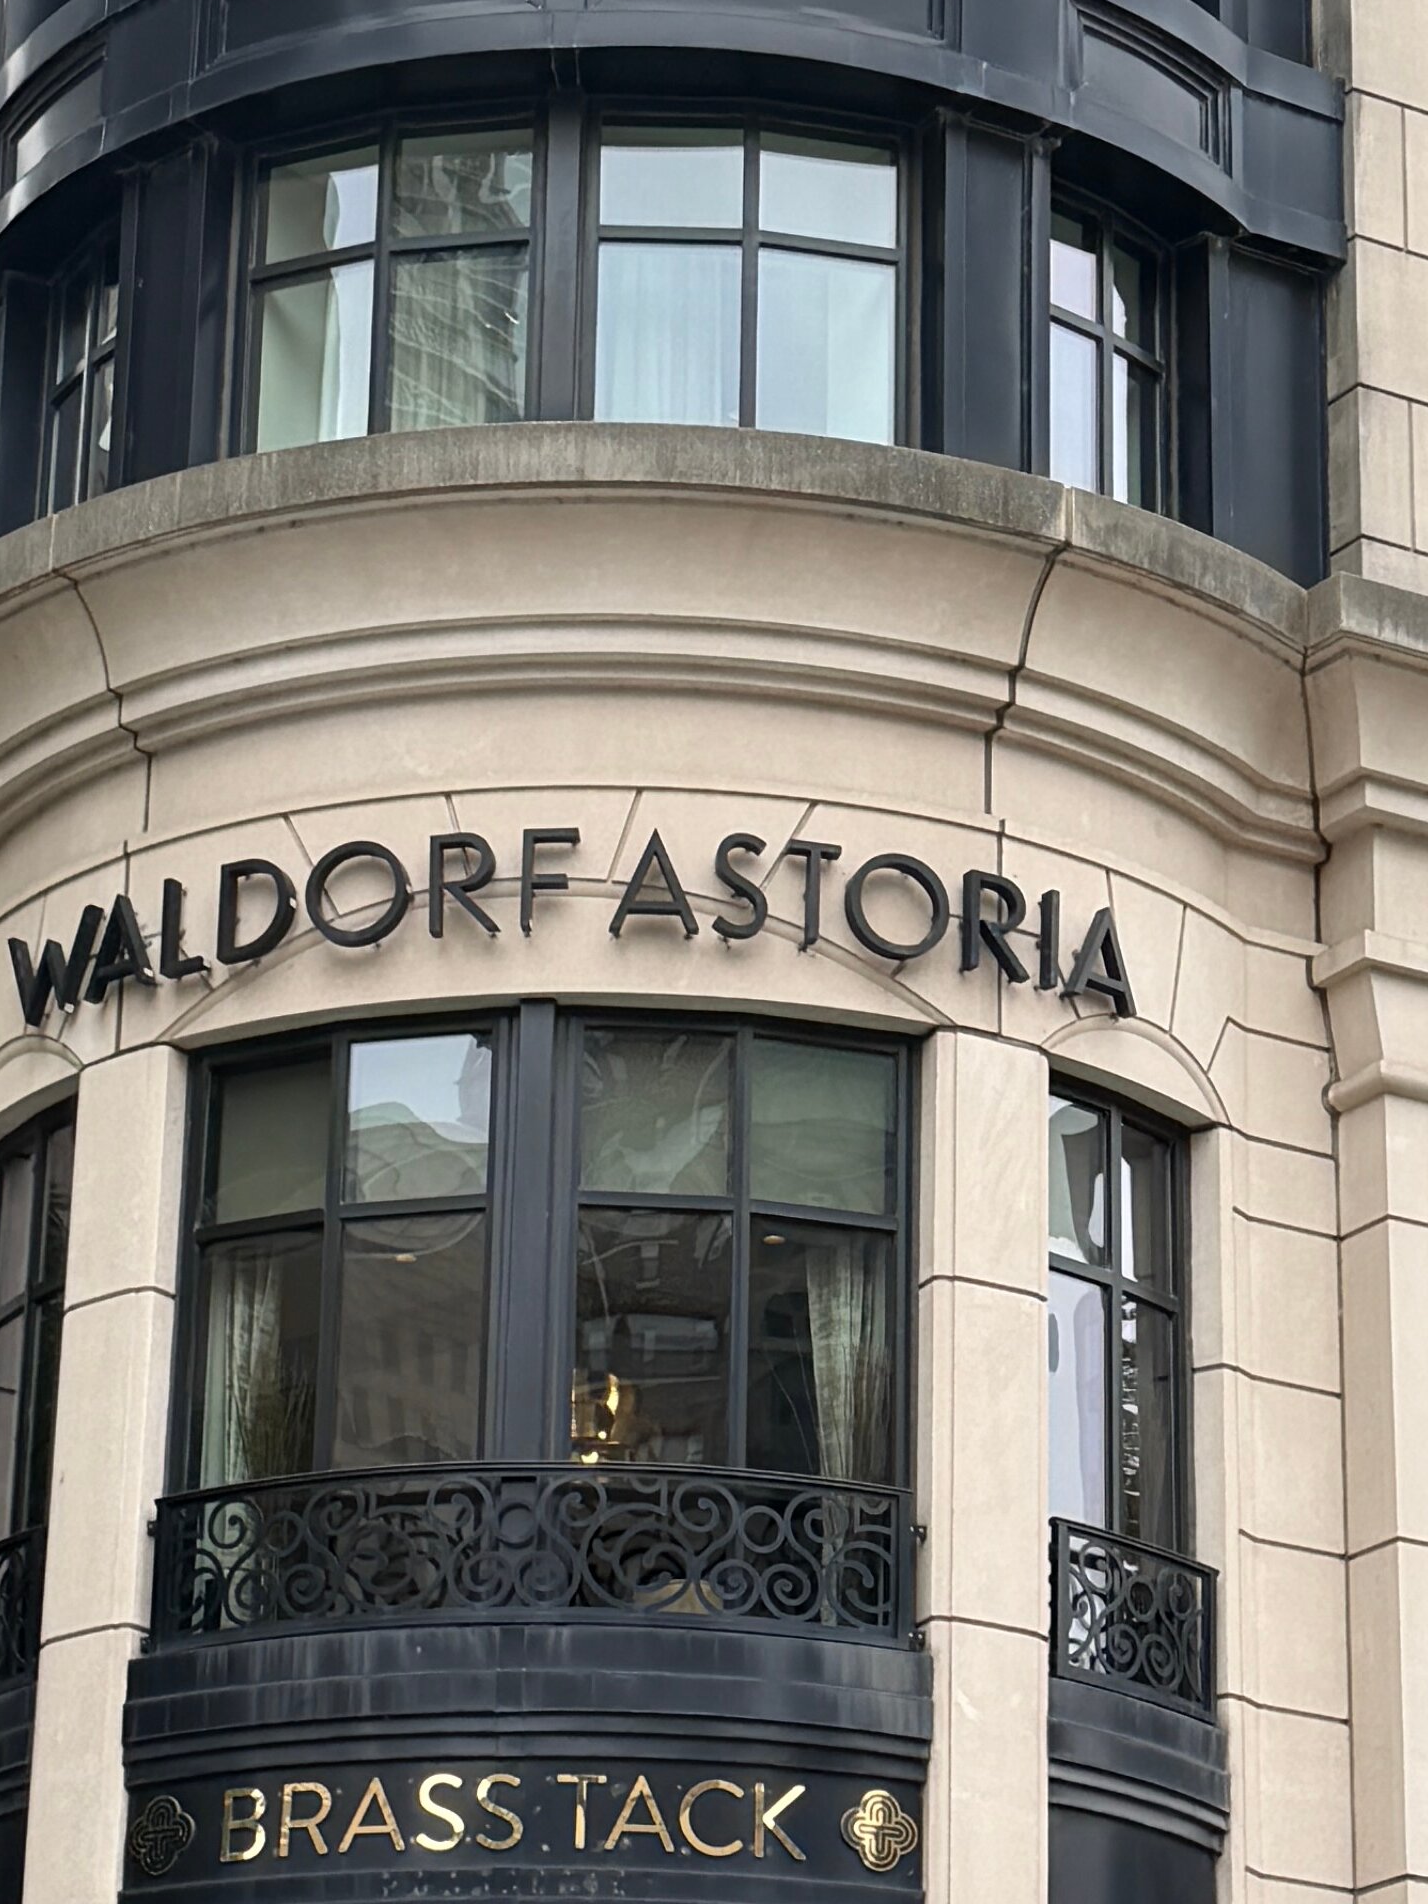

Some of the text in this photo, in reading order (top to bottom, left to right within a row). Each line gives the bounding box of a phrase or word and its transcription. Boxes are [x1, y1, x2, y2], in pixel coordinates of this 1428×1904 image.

[8, 827, 1139, 1027] WALDORF ASTORIA
[218, 1772, 806, 1864] BRASS TACK
